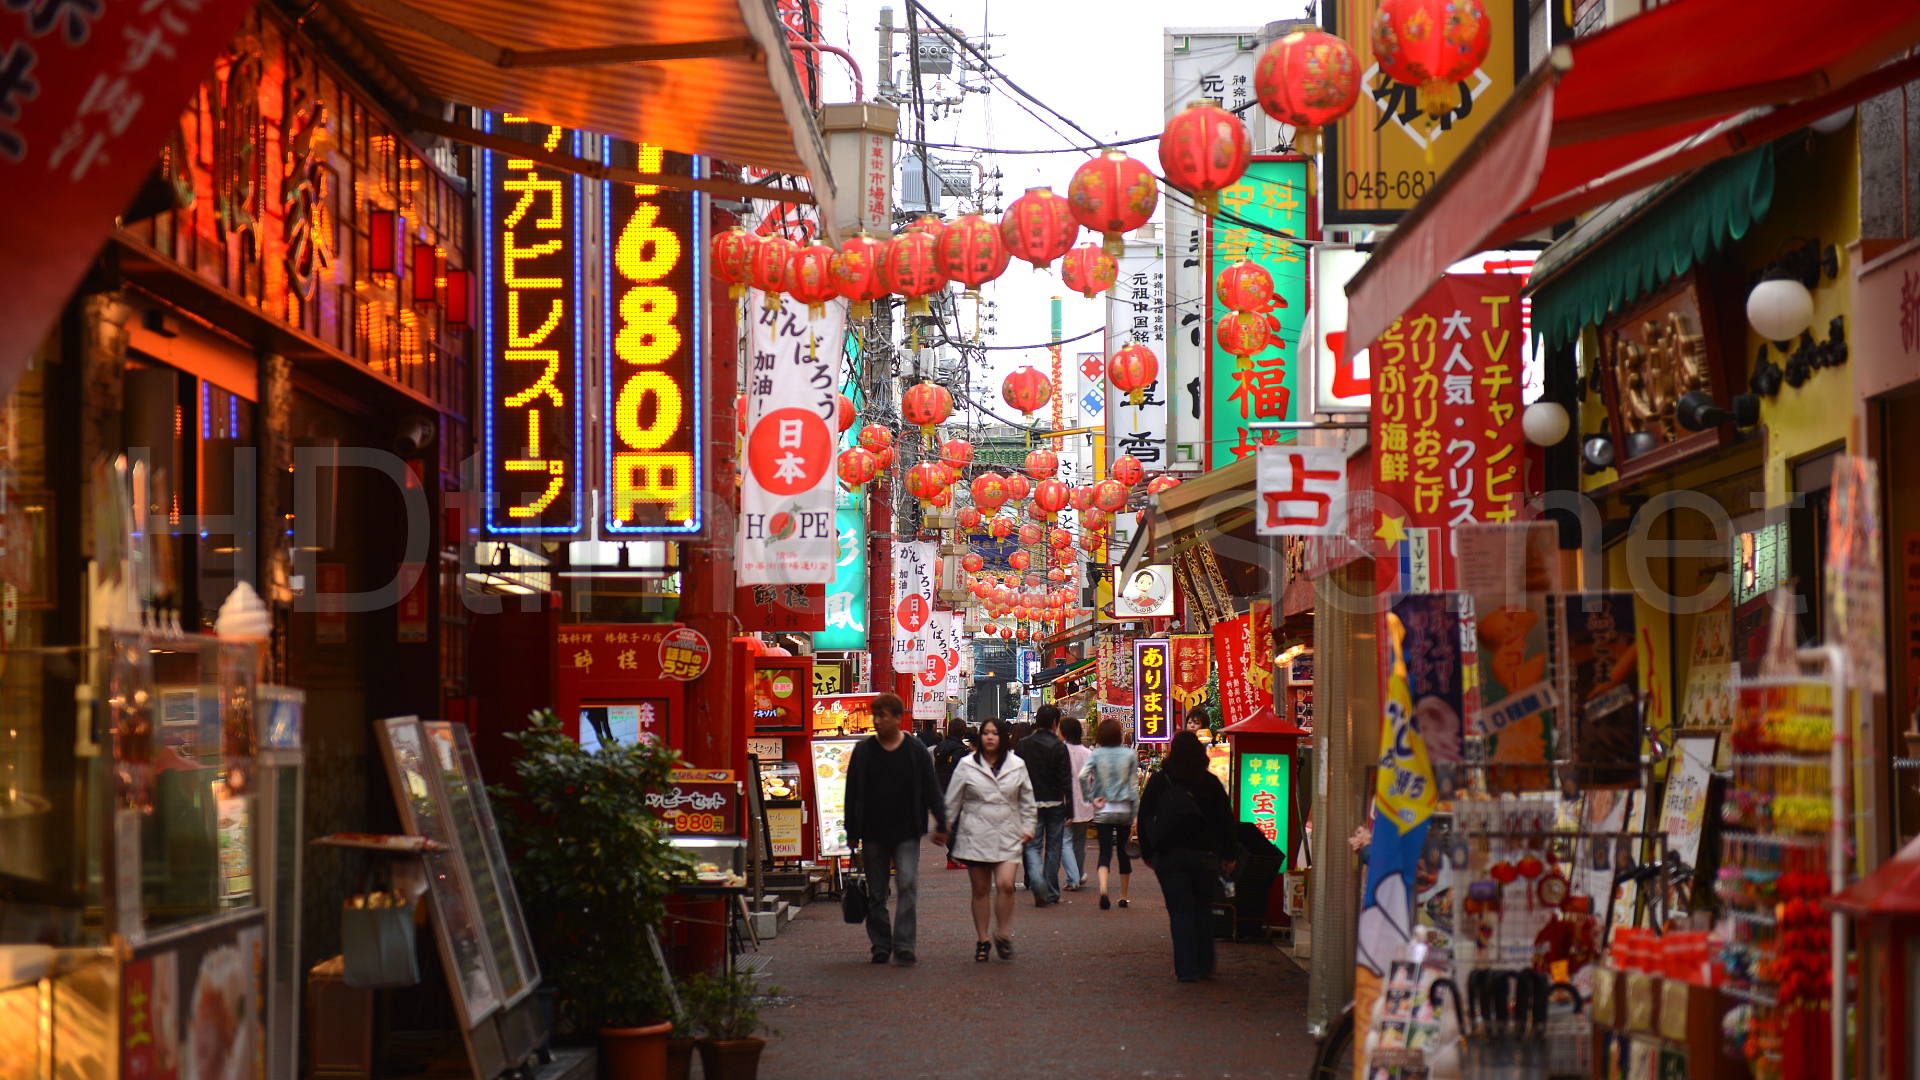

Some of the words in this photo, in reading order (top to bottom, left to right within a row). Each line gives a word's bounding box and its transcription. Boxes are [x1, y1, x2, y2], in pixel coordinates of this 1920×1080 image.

[868, 135, 886, 227] 中華街市場通り
[760, 298, 835, 420] がんばろう
[1410, 313, 1445, 514] カリカリおこげ
[775, 417, 804, 485] 日本
[1263, 453, 1341, 527] 占
[900, 546, 931, 601] がんばろう
[909, 598, 920, 628] 日本
[663, 661, 702, 677] ランチ
[1142, 647, 1164, 735] あります
[747, 742, 782, 754] セット
[675, 813, 725, 832] 980円
